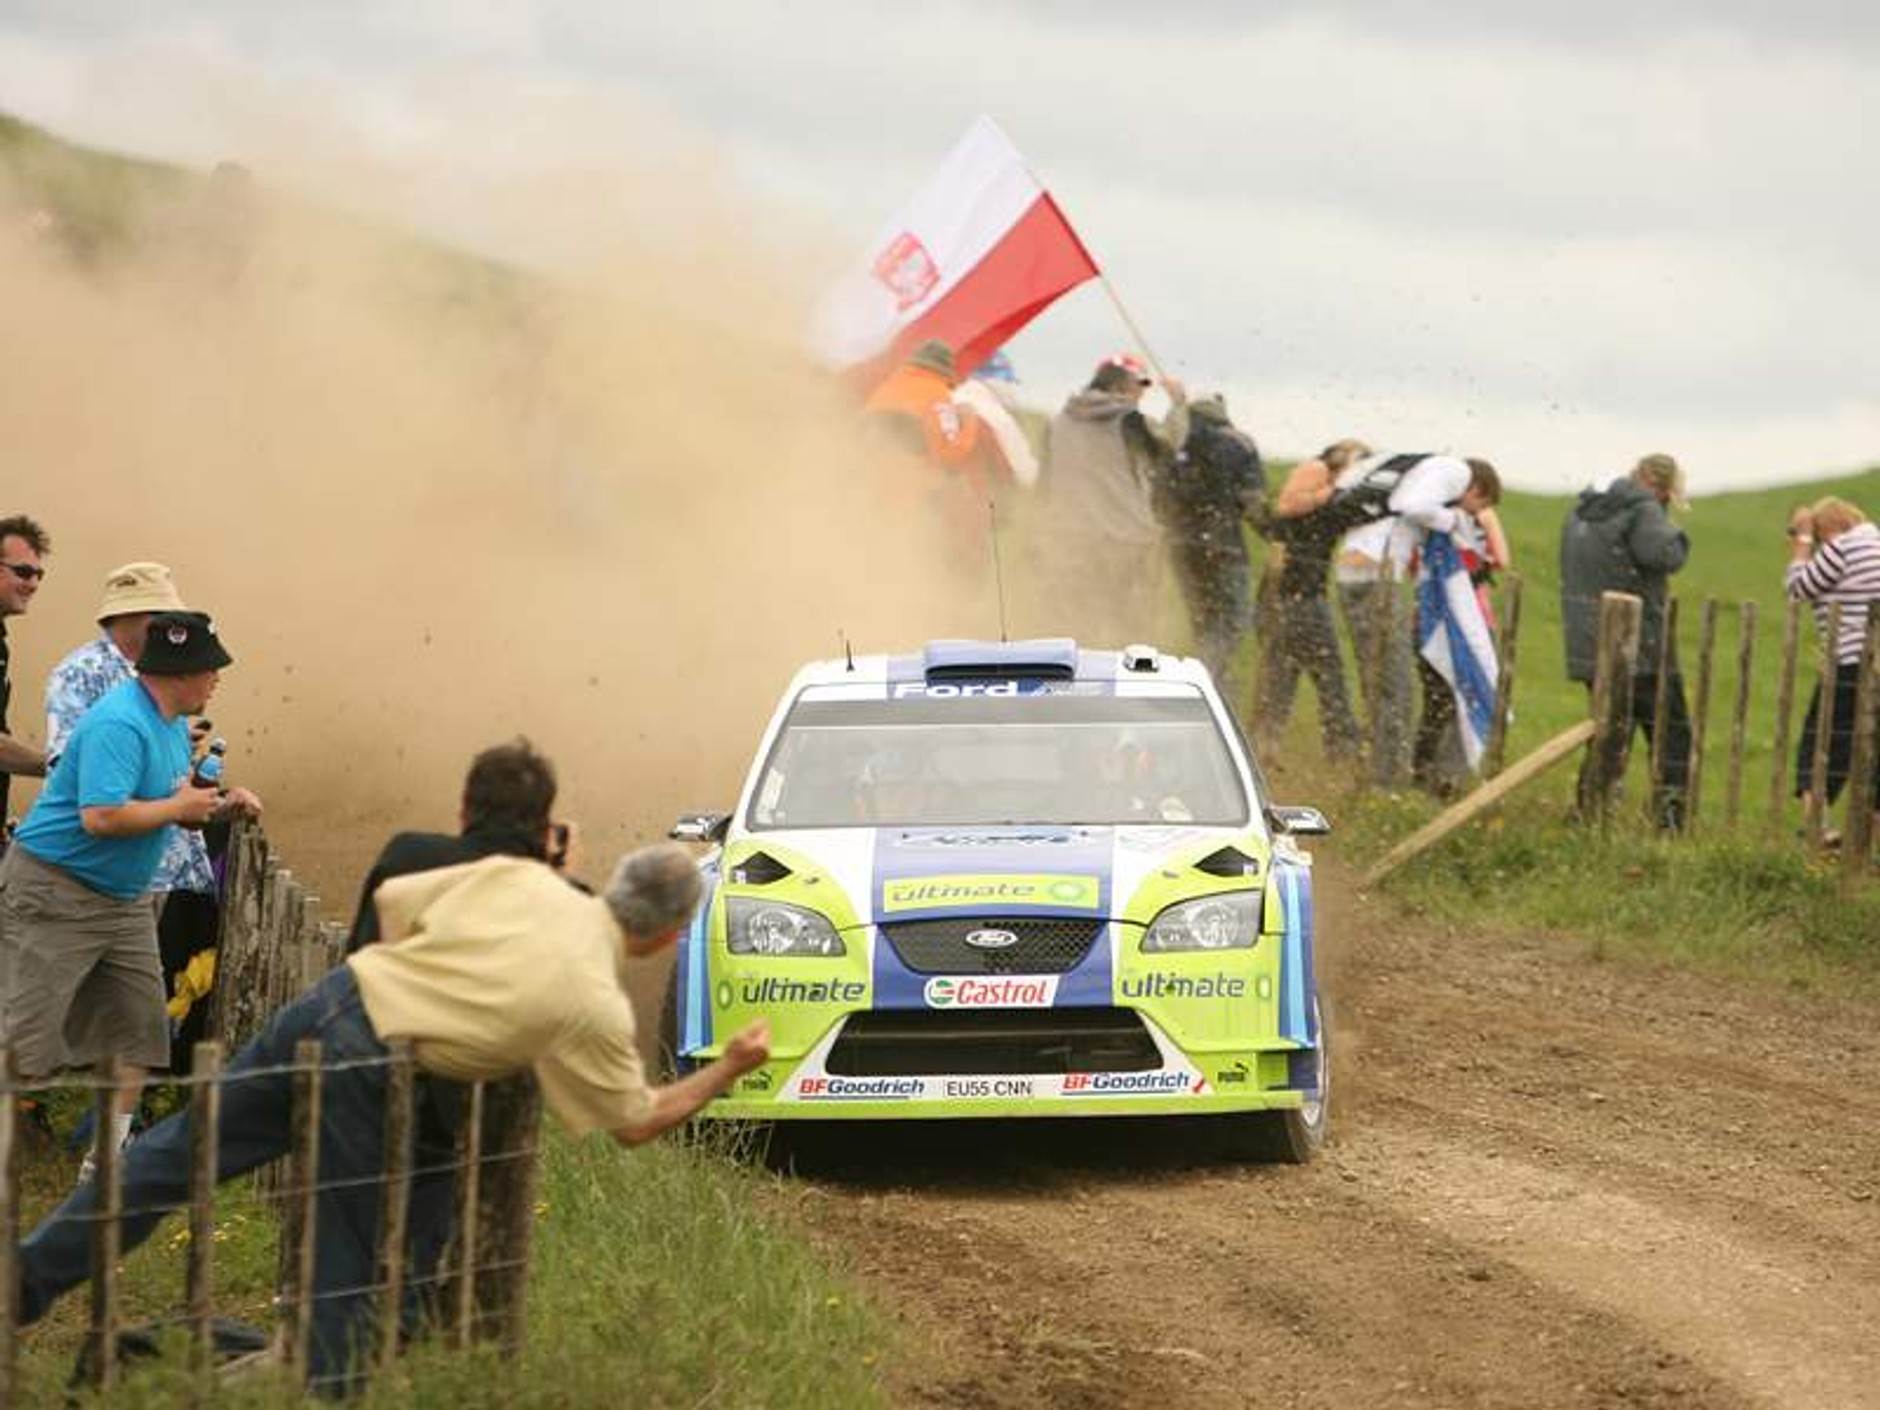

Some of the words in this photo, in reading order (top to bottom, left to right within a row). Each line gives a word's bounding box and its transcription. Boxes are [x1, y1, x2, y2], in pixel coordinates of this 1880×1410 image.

[895, 682, 1017, 698] Ford
[892, 882, 1035, 901] ultimate
[742, 977, 866, 1003] ultimate
[957, 979, 1047, 1005] Castrol
[800, 1078, 925, 1095] BFGoodrich
[946, 1081, 990, 1096] EU55
[993, 1081, 1032, 1096] CNN
[1063, 1071, 1190, 1090] BFGoodrich
